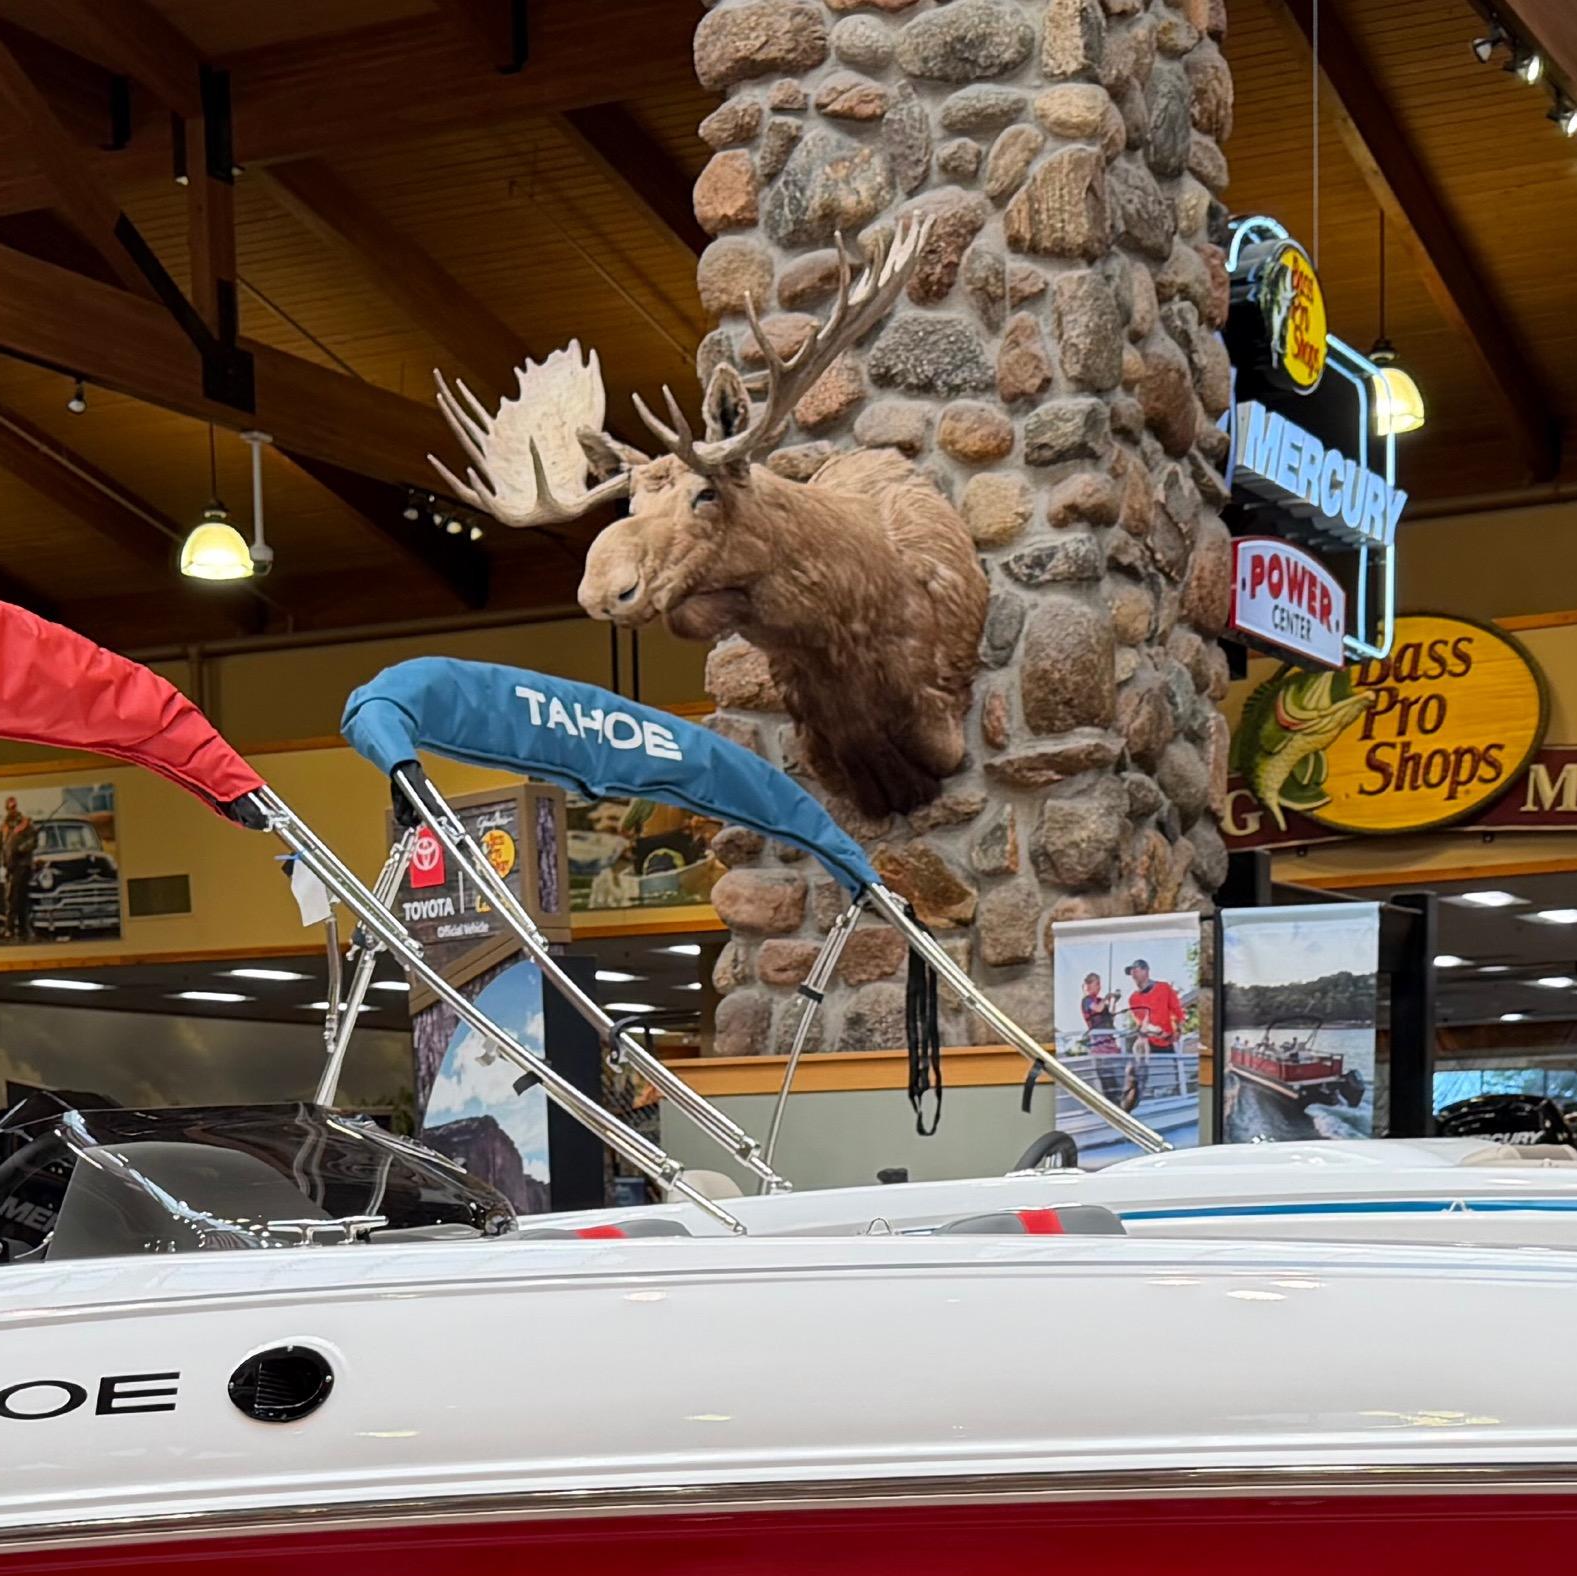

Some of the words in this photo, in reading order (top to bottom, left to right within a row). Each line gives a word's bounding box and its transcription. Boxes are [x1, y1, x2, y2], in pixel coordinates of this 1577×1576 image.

[1236, 400, 1408, 547] MERCURY
[1249, 554, 1333, 634] POWER
[1272, 604, 1312, 642] CENTER
[1355, 637, 1473, 687] Bass
[515, 685, 682, 761] TAHOE
[1358, 686, 1447, 741] Pro
[1358, 742, 1505, 800] Shops
[403, 897, 455, 921] TOYOTA
[1476, 1130, 1545, 1145] RCURY
